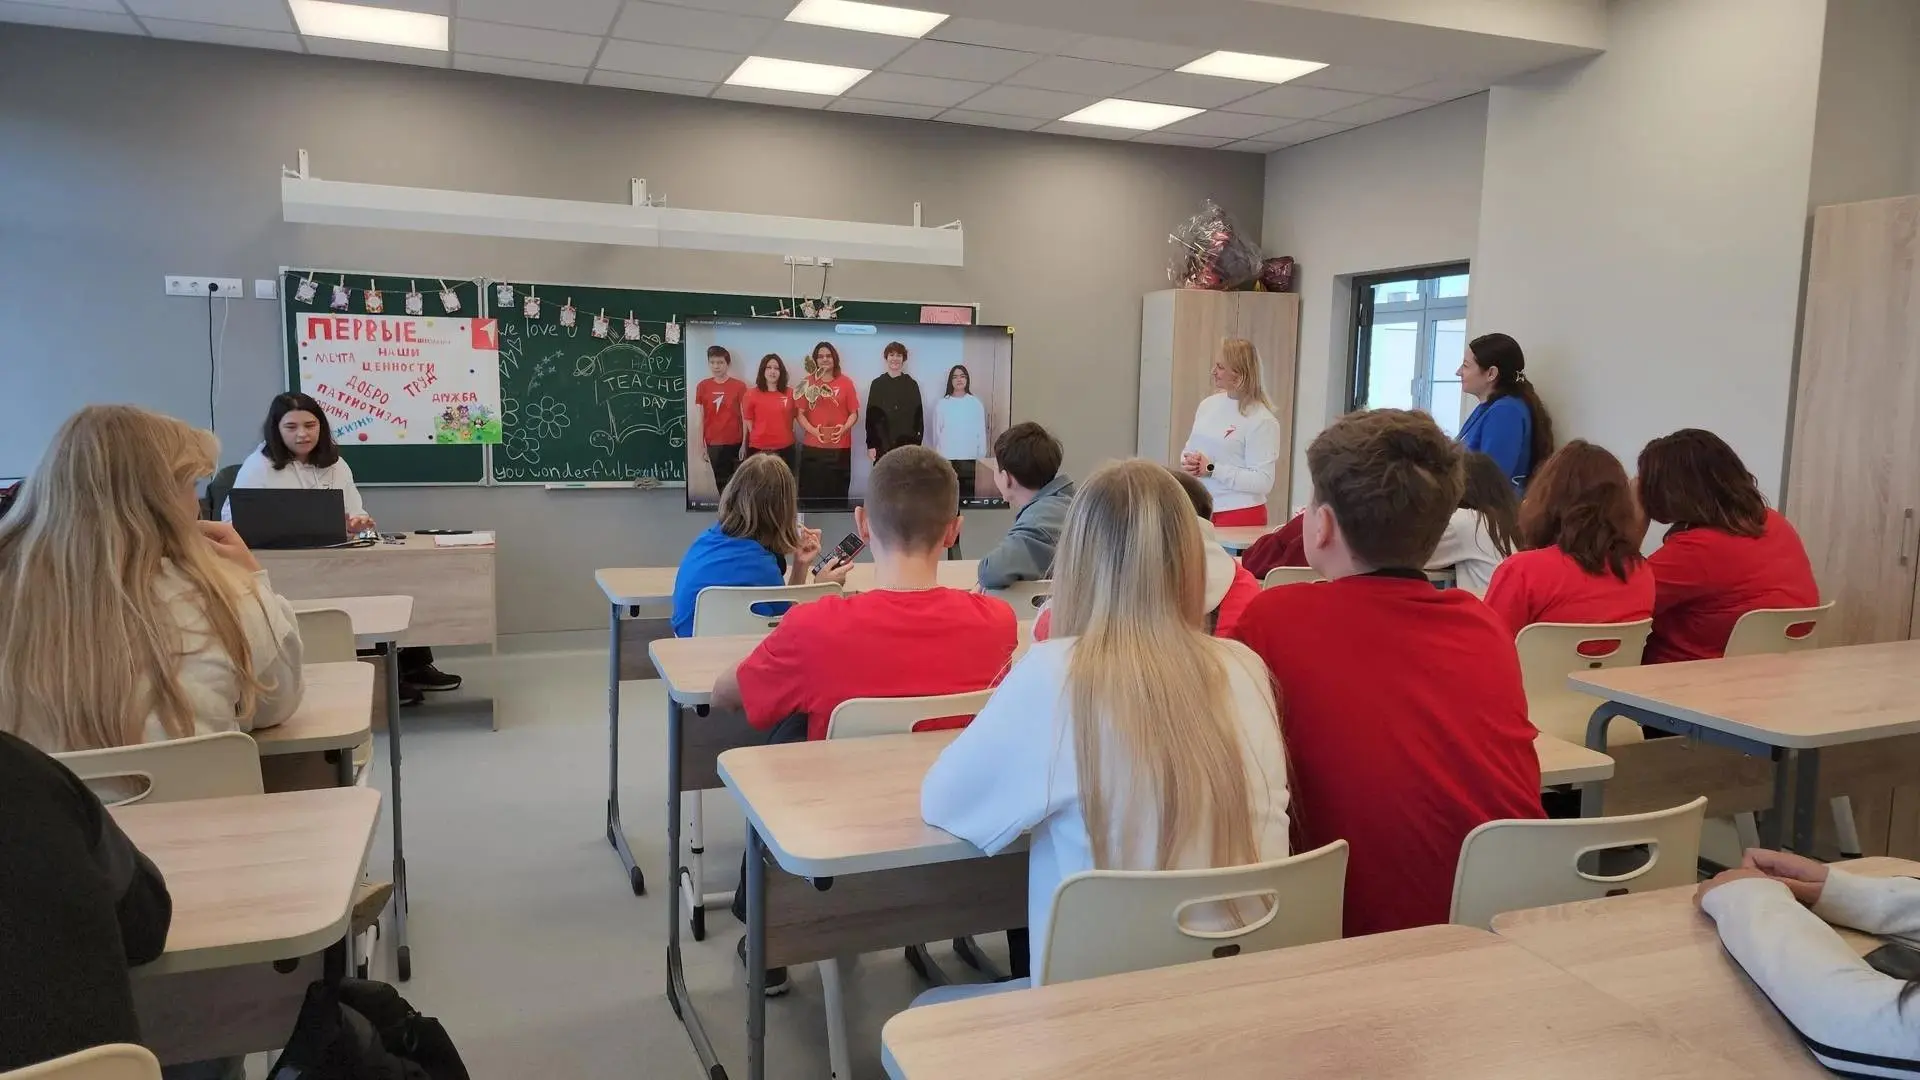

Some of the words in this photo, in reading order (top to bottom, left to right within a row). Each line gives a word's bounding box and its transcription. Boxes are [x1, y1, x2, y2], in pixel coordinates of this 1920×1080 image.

[308, 317, 416, 342] ПЕРВЫЕ
[526, 316, 558, 338] love
[315, 352, 356, 364] МЕЧТА
[378, 347, 420, 357] НАШИ
[362, 362, 435, 373] ЦЕННОСТИ
[631, 356, 672, 372] HAPPY
[345, 376, 389, 405] ДОБРО
[403, 369, 438, 397] ТРУД
[313, 398, 349, 421] ОДИНА
[316, 383, 408, 430] ПАТРИОТИЗМ
[642, 396, 667, 410] DAY
[332, 415, 374, 438] ЖИЗНЬ
[495, 465, 525, 480] you
